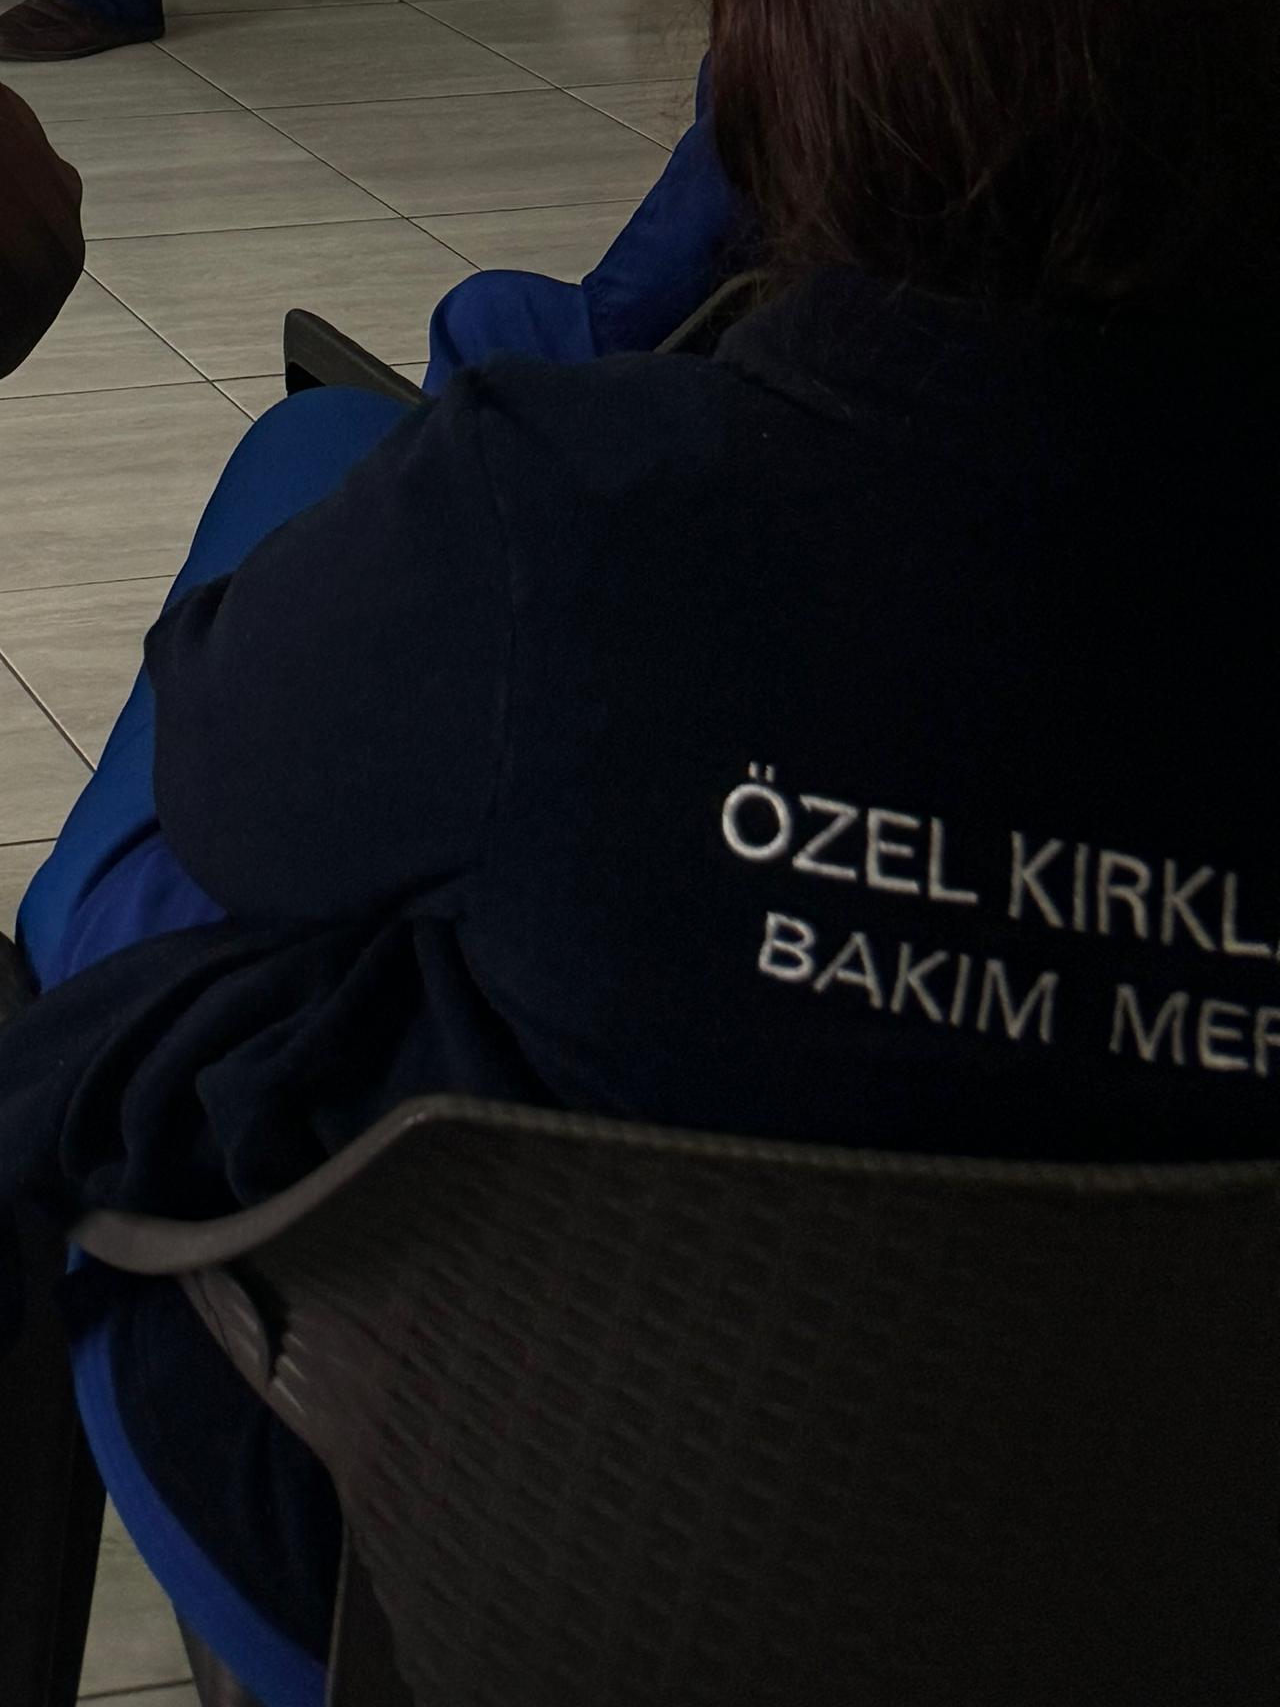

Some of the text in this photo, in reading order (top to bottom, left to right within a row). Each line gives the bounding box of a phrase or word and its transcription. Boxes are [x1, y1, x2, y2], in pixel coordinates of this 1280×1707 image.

[722, 761, 1279, 959] ÖZEL KIRKL
[757, 911, 1059, 1044] BAKIM
